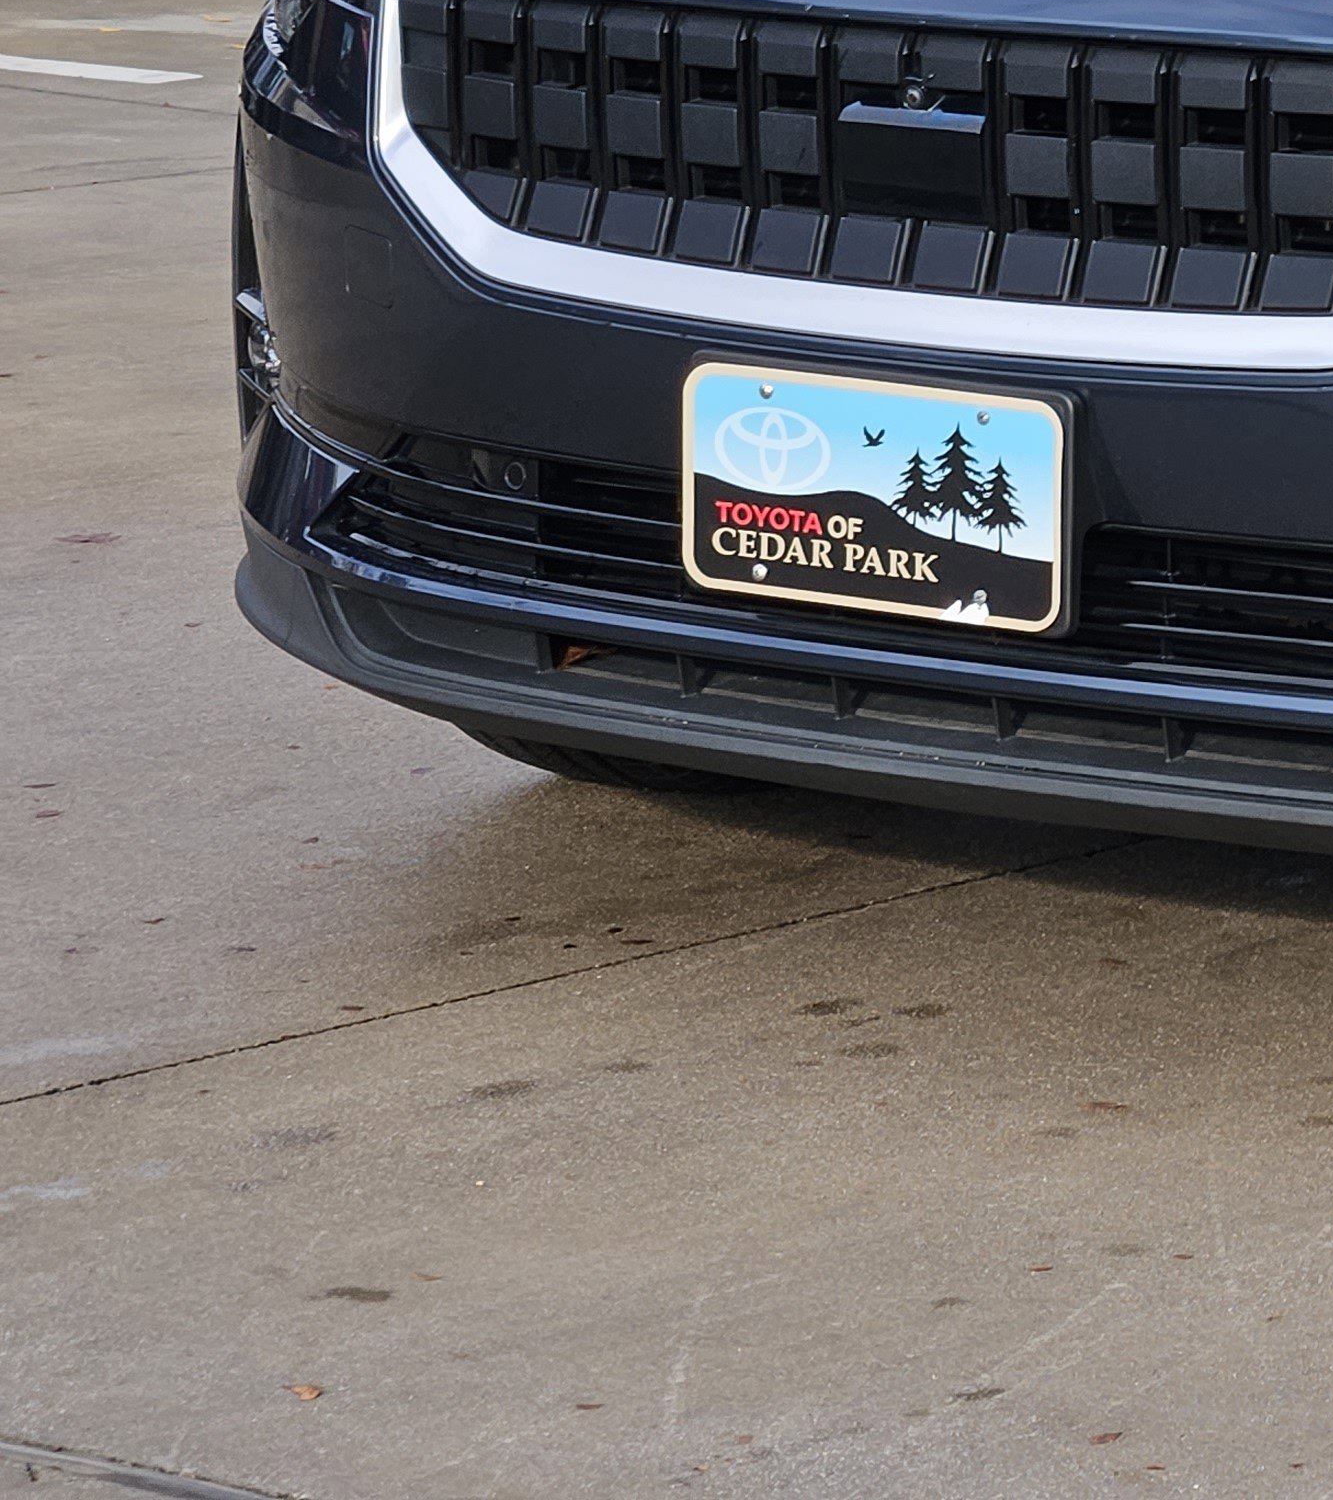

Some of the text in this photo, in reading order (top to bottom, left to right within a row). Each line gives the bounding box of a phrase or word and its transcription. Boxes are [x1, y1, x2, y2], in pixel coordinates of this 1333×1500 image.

[714, 500, 864, 541] TOYOTA OF
[711, 527, 939, 583] CEDAR PARK
